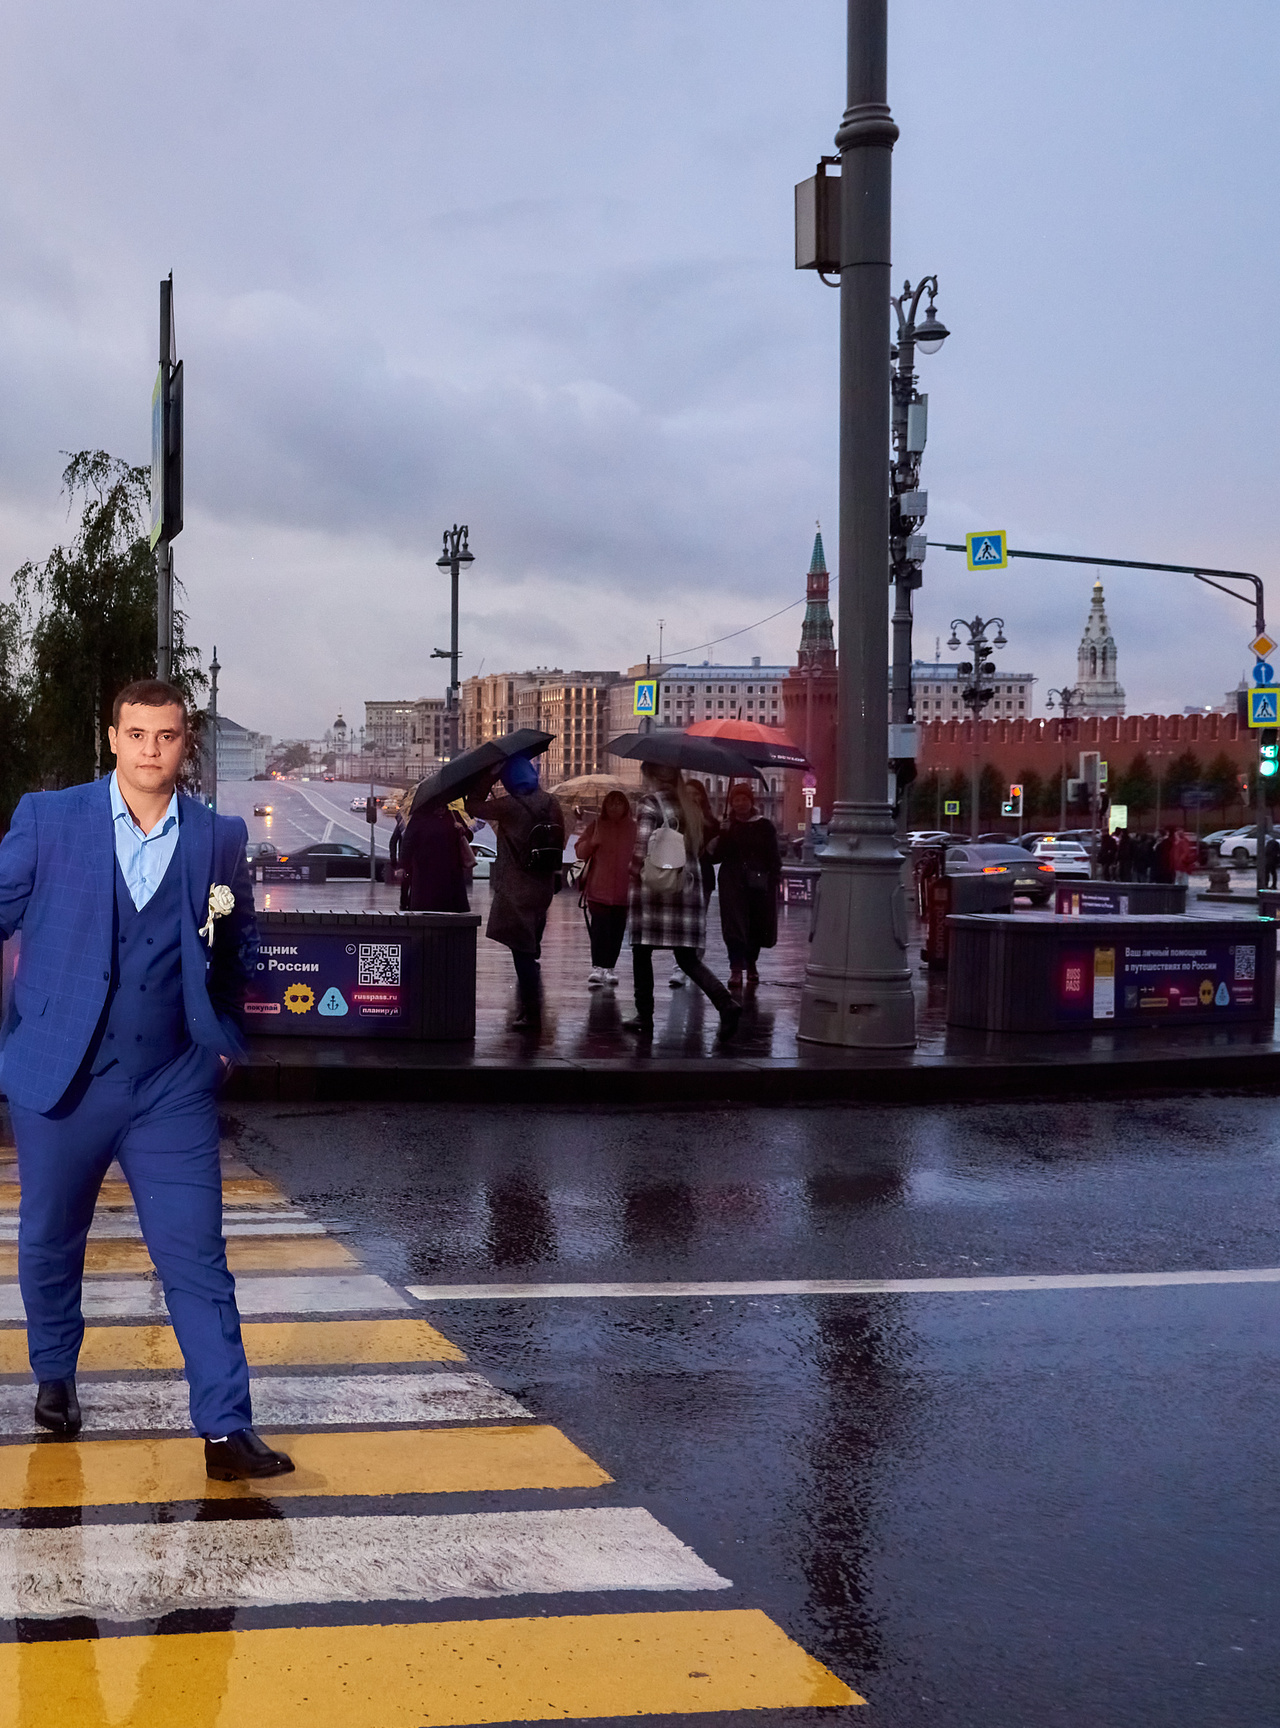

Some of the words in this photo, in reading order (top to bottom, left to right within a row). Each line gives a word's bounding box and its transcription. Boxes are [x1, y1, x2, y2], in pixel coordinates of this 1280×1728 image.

[1260, 746, 1274, 758] 46
[257, 946, 298, 956] щник
[1125, 947, 1141, 957] Ваш
[1142, 947, 1169, 957] личный
[1170, 949, 1207, 958] помощник
[268, 959, 319, 972] России
[1131, 964, 1181, 974] путешествиях
[1192, 961, 1217, 970] России
[1066, 968, 1080, 979] RUSS
[1066, 980, 1080, 991] PASS
[247, 1004, 278, 1012] покупай
[362, 1007, 398, 1015] планируй
